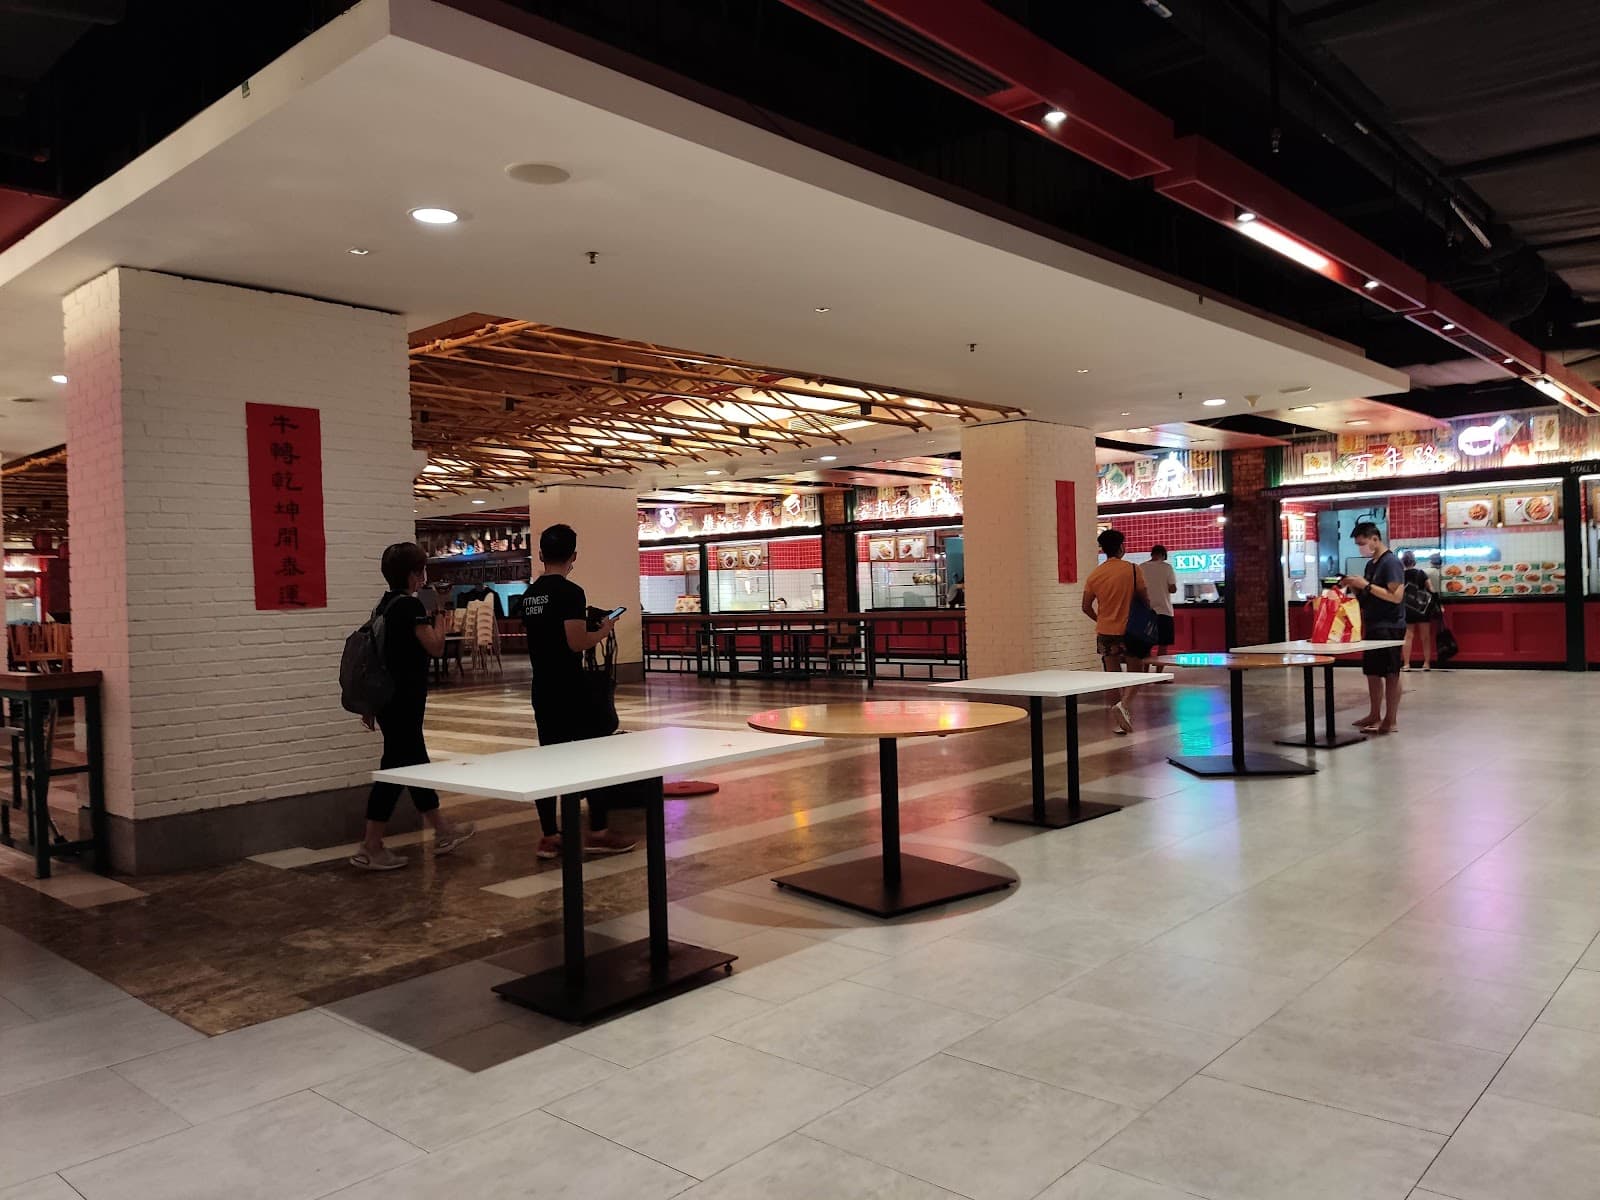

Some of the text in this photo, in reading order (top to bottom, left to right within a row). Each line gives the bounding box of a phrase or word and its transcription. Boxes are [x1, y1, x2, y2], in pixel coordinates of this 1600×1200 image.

[270, 415, 306, 608] 牛轉乾坤開泰運
[1175, 555, 1207, 569] KIN
[525, 605, 544, 616] CREW
